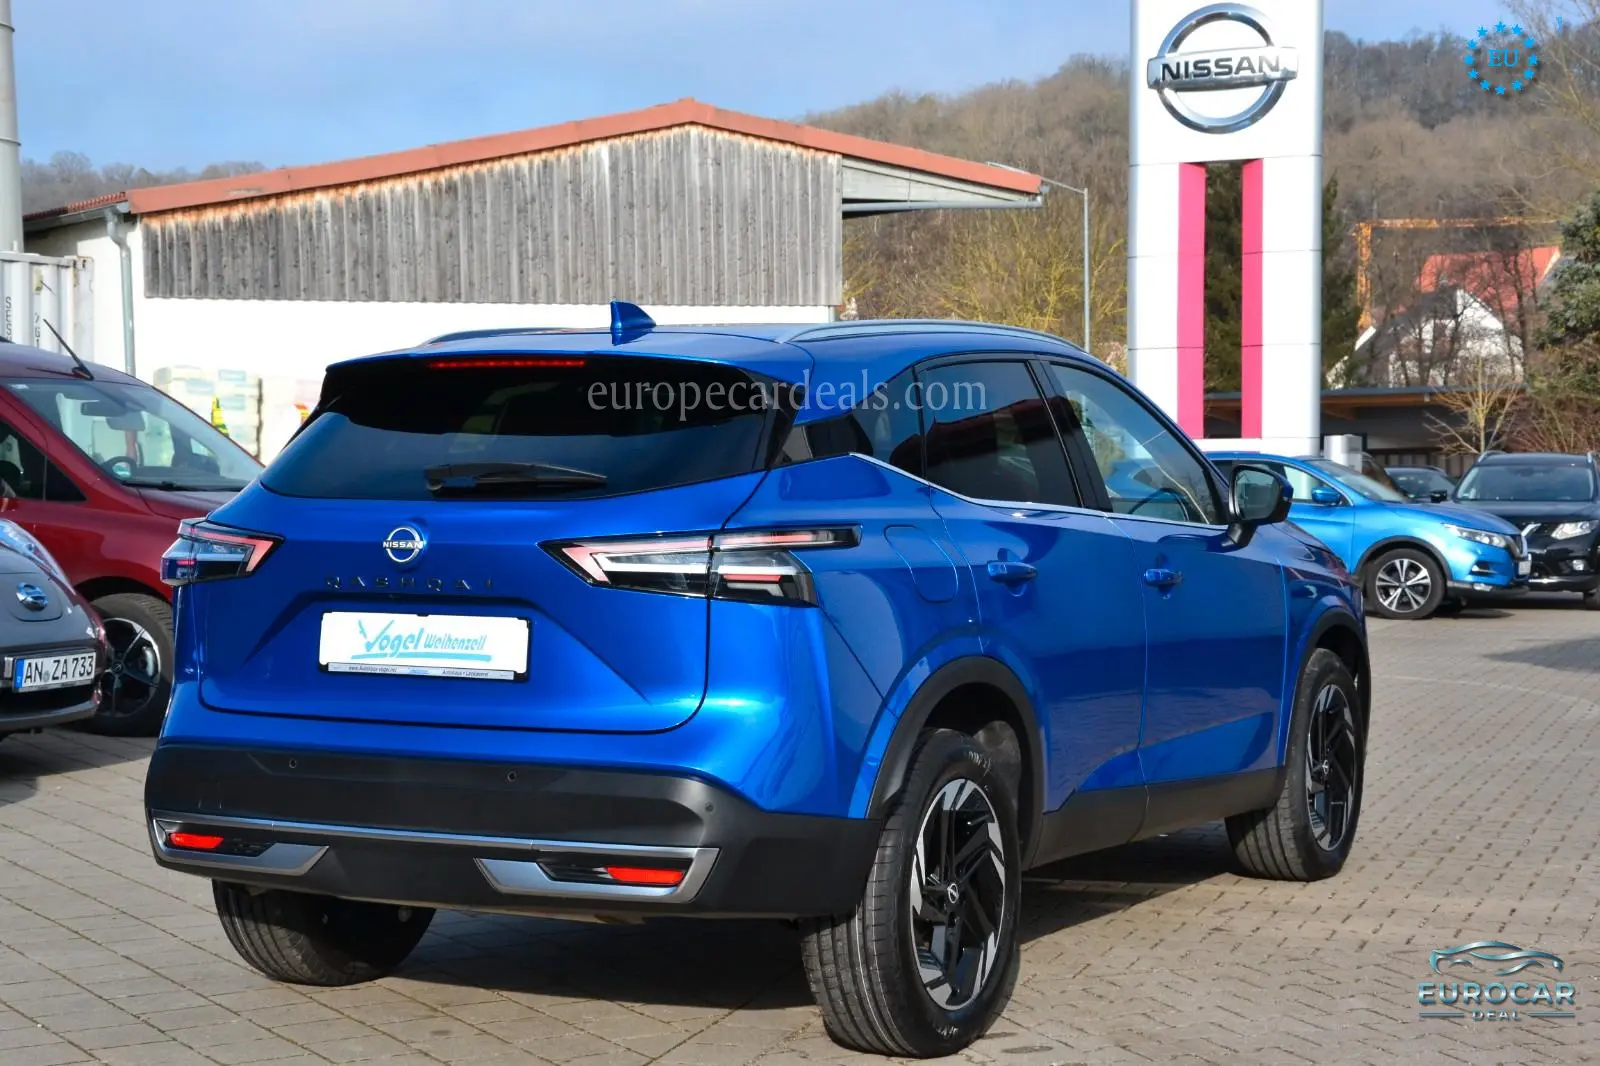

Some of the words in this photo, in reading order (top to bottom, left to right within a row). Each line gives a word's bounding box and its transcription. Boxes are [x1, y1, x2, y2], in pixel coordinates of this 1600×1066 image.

[1160, 54, 1281, 82] NISSAN
[382, 541, 424, 549] NISSAN
[357, 619, 425, 658] Vogel
[24, 661, 43, 684] AN
[51, 659, 68, 681] ZA
[72, 656, 94, 678] 733
